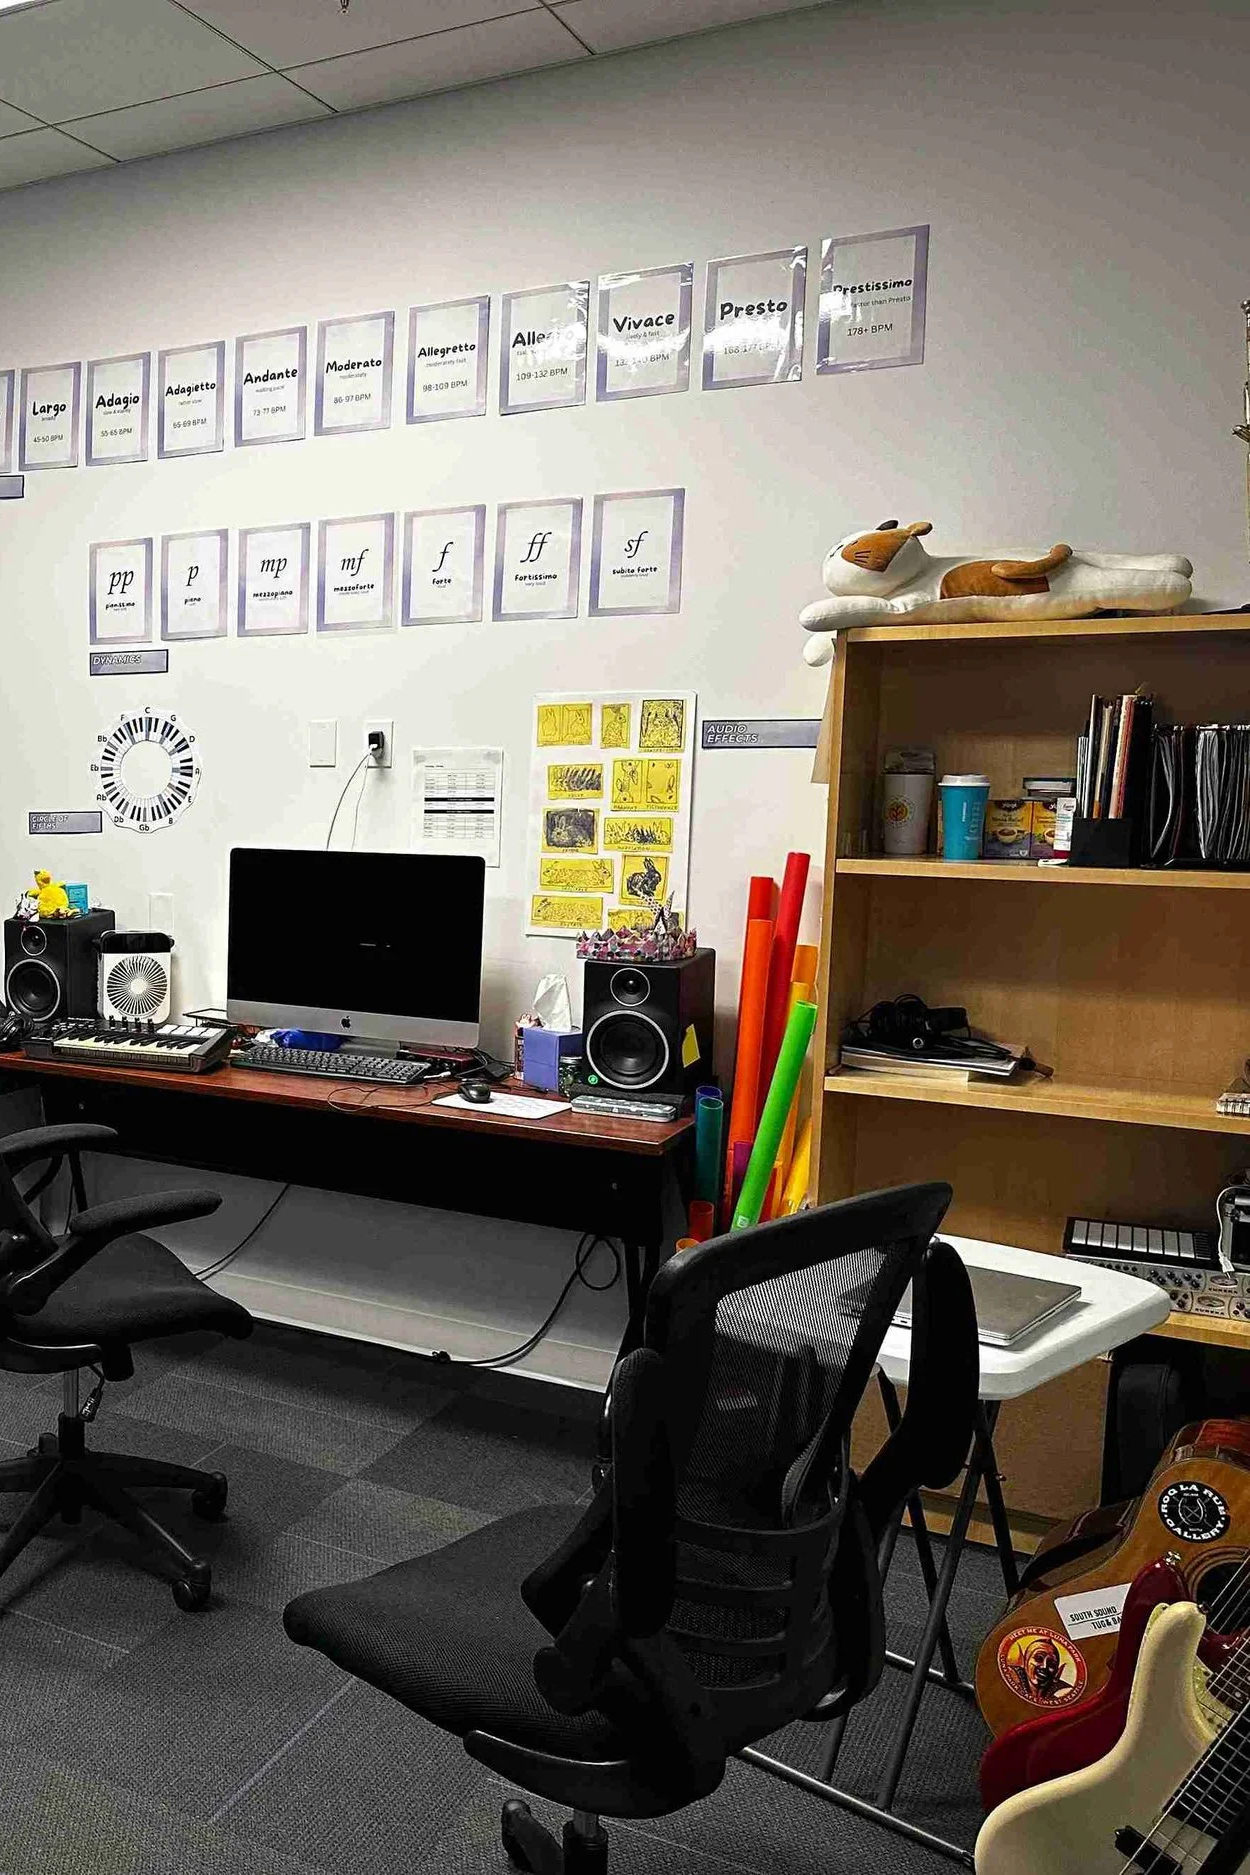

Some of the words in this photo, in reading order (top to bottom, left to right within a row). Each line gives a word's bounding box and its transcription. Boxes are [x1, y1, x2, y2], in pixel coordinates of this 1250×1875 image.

[833, 279, 912, 296] Prestissimo
[719, 299, 788, 320] Presto
[613, 313, 675, 333] Vivace
[847, 327, 869, 337] 178+
[871, 323, 893, 334] BPM
[417, 343, 476, 358] Allegretto
[650, 353, 669, 362] BPM
[326, 358, 382, 374] Moderato
[243, 368, 298, 386] Andante
[517, 370, 547, 381] 109-132
[549, 367, 568, 377] BPM
[165, 381, 216, 397] Adagietto
[451, 380, 468, 389] BPM
[95, 393, 140, 409] Adagio
[355, 392, 371, 402] BPM
[32, 401, 67, 417] Largo
[271, 405, 286, 414] BPM
[192, 417, 207, 426] BPM
[50, 434, 64, 442] BPM
[118, 428, 132, 436] BPM
[520, 531, 552, 563] ff
[624, 530, 649, 559] sf
[341, 548, 369, 577] mf
[431, 541, 454, 572] f
[260, 557, 287, 579] mp
[637, 566, 659, 574] forte
[107, 570, 134, 595] pp
[186, 565, 199, 586] p
[432, 578, 451, 586] forte
[515, 573, 558, 582] fortissimo
[184, 597, 201, 605] piano
[93, 655, 142, 665] DYNAMICS
[707, 725, 747, 733] AUDIO
[97, 735, 107, 743] Bb
[707, 734, 758, 743] EFFECTS
[90, 764, 99, 772] Eb
[113, 815, 125, 823] Db
[139, 824, 150, 832] Gb
[1161, 1488, 1178, 1513] ROQ
[1203, 1488, 1226, 1515] RUE
[1166, 1518, 1224, 1540] GALLERY
[1069, 1610, 1093, 1622] SOUTH
[1094, 1606, 1117, 1617] SOUND
[1010, 1630, 1026, 1641] MEET
[1050, 1632, 1068, 1646] LUNA
